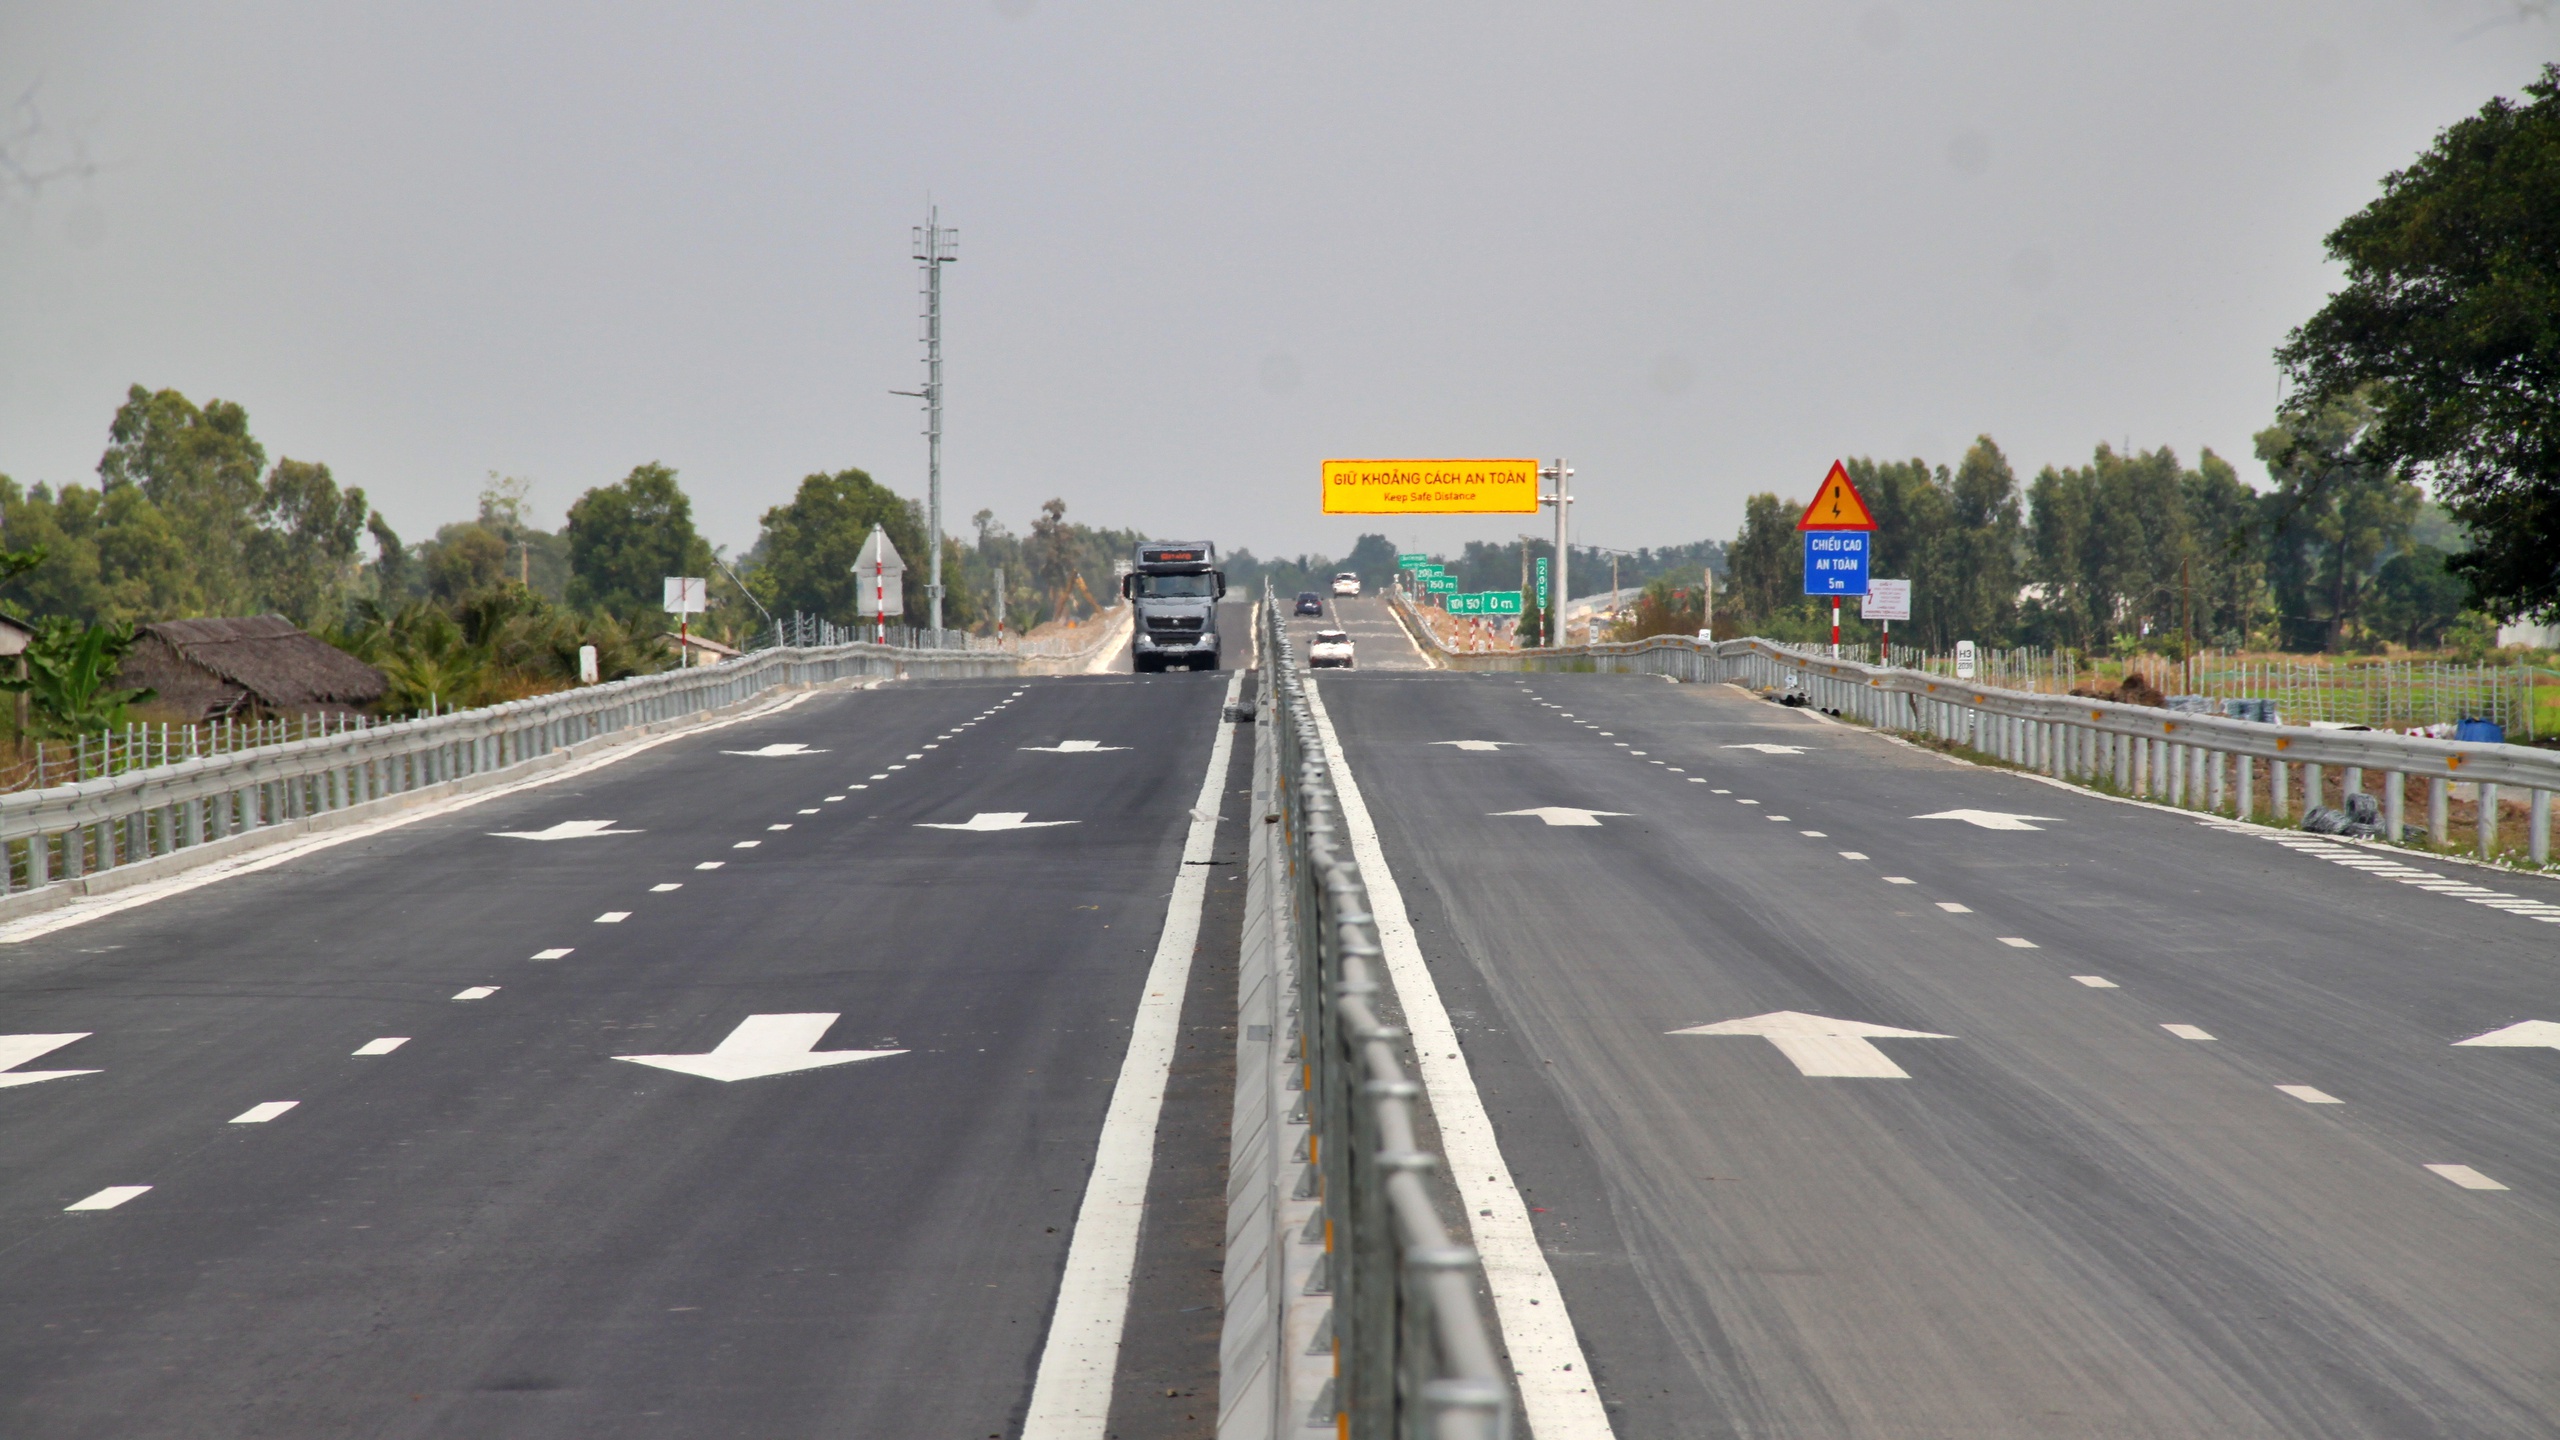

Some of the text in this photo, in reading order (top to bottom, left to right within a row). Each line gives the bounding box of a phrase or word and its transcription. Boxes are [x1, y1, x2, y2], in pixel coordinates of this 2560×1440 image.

[1362, 469, 1420, 485] KHOẢNG
[1424, 470, 1460, 484] CÁCH
[1465, 473, 1485, 484] AN
[1489, 470, 1526, 484] TOÀN
[1384, 492, 1476, 503] Keep Safe Distance
[1843, 539, 1862, 551] CAO
[1816, 557, 1858, 570] AN TOÀN
[1829, 577, 1845, 589] 5m
[1501, 600, 1513, 609] m
[1959, 649, 1972, 658] H3
